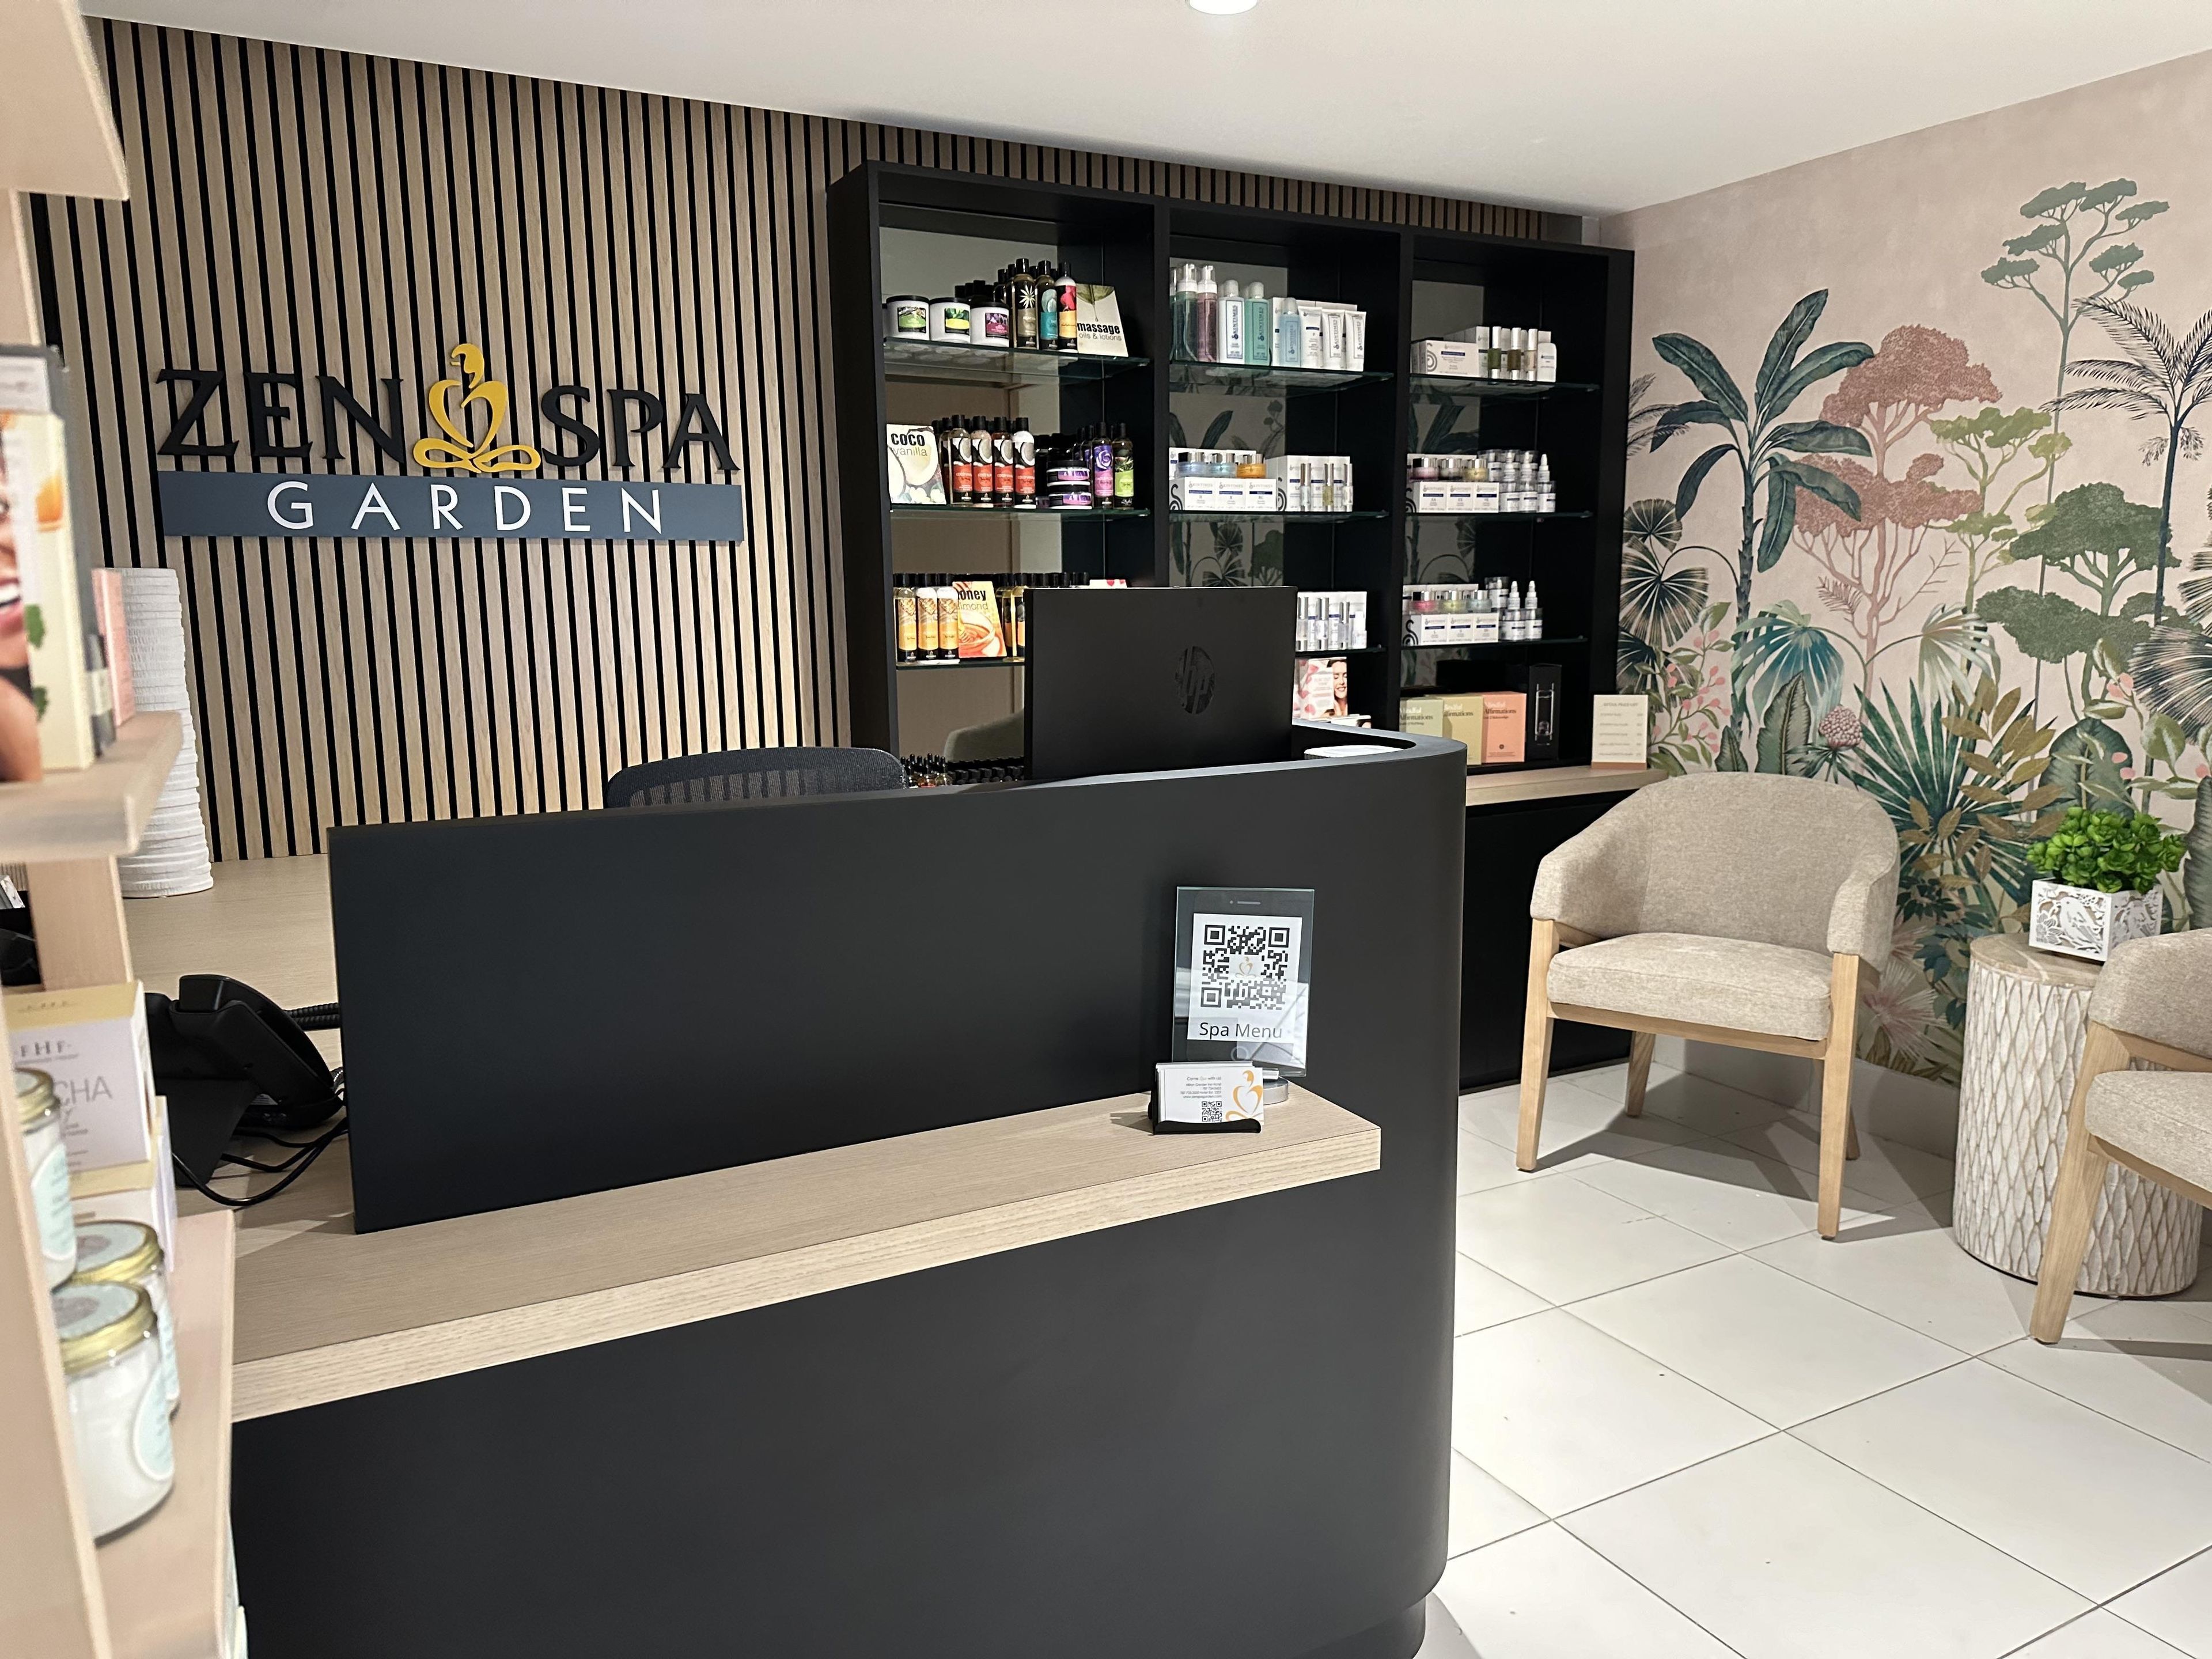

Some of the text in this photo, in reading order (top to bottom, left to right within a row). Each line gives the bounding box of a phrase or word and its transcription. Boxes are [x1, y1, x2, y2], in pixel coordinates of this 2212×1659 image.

[1077, 322, 1120, 335] massage
[156, 369, 741, 471] ZEN SPA
[893, 447, 927, 456] vanilla
[267, 480, 662, 535] GARDEN
[1199, 1022, 1282, 1040] Spa Menu
